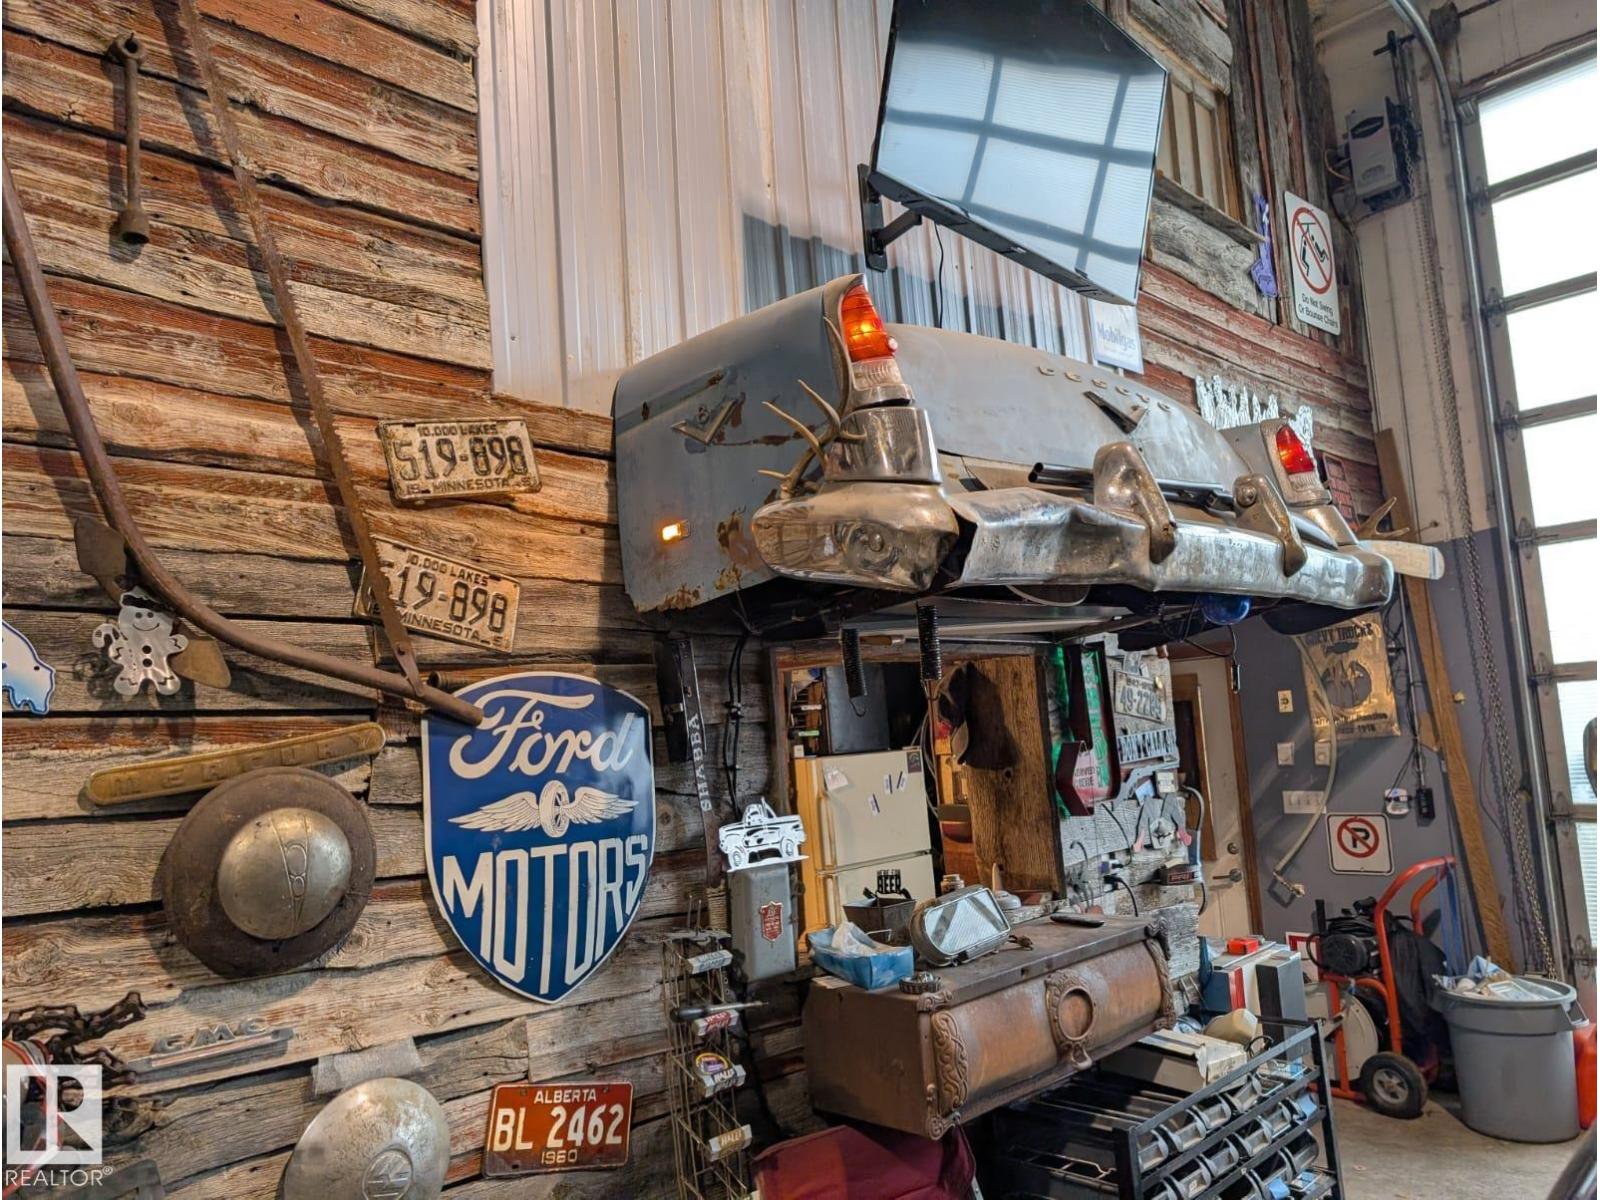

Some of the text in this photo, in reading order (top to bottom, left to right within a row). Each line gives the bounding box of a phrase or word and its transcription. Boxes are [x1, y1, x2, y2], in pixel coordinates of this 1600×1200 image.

[459, 424, 499, 436] LAKES
[393, 435, 529, 481] 519-898
[431, 478, 511, 492] MINNESOTA
[381, 559, 508, 634] 19-898
[450, 566, 490, 587] LAKES
[449, 689, 635, 779] Ford
[442, 833, 649, 995] MOTORS
[150, 1017, 267, 1054] GMC
[533, 1088, 597, 1104] ALBERTA
[493, 1103, 625, 1151] BL 2462
